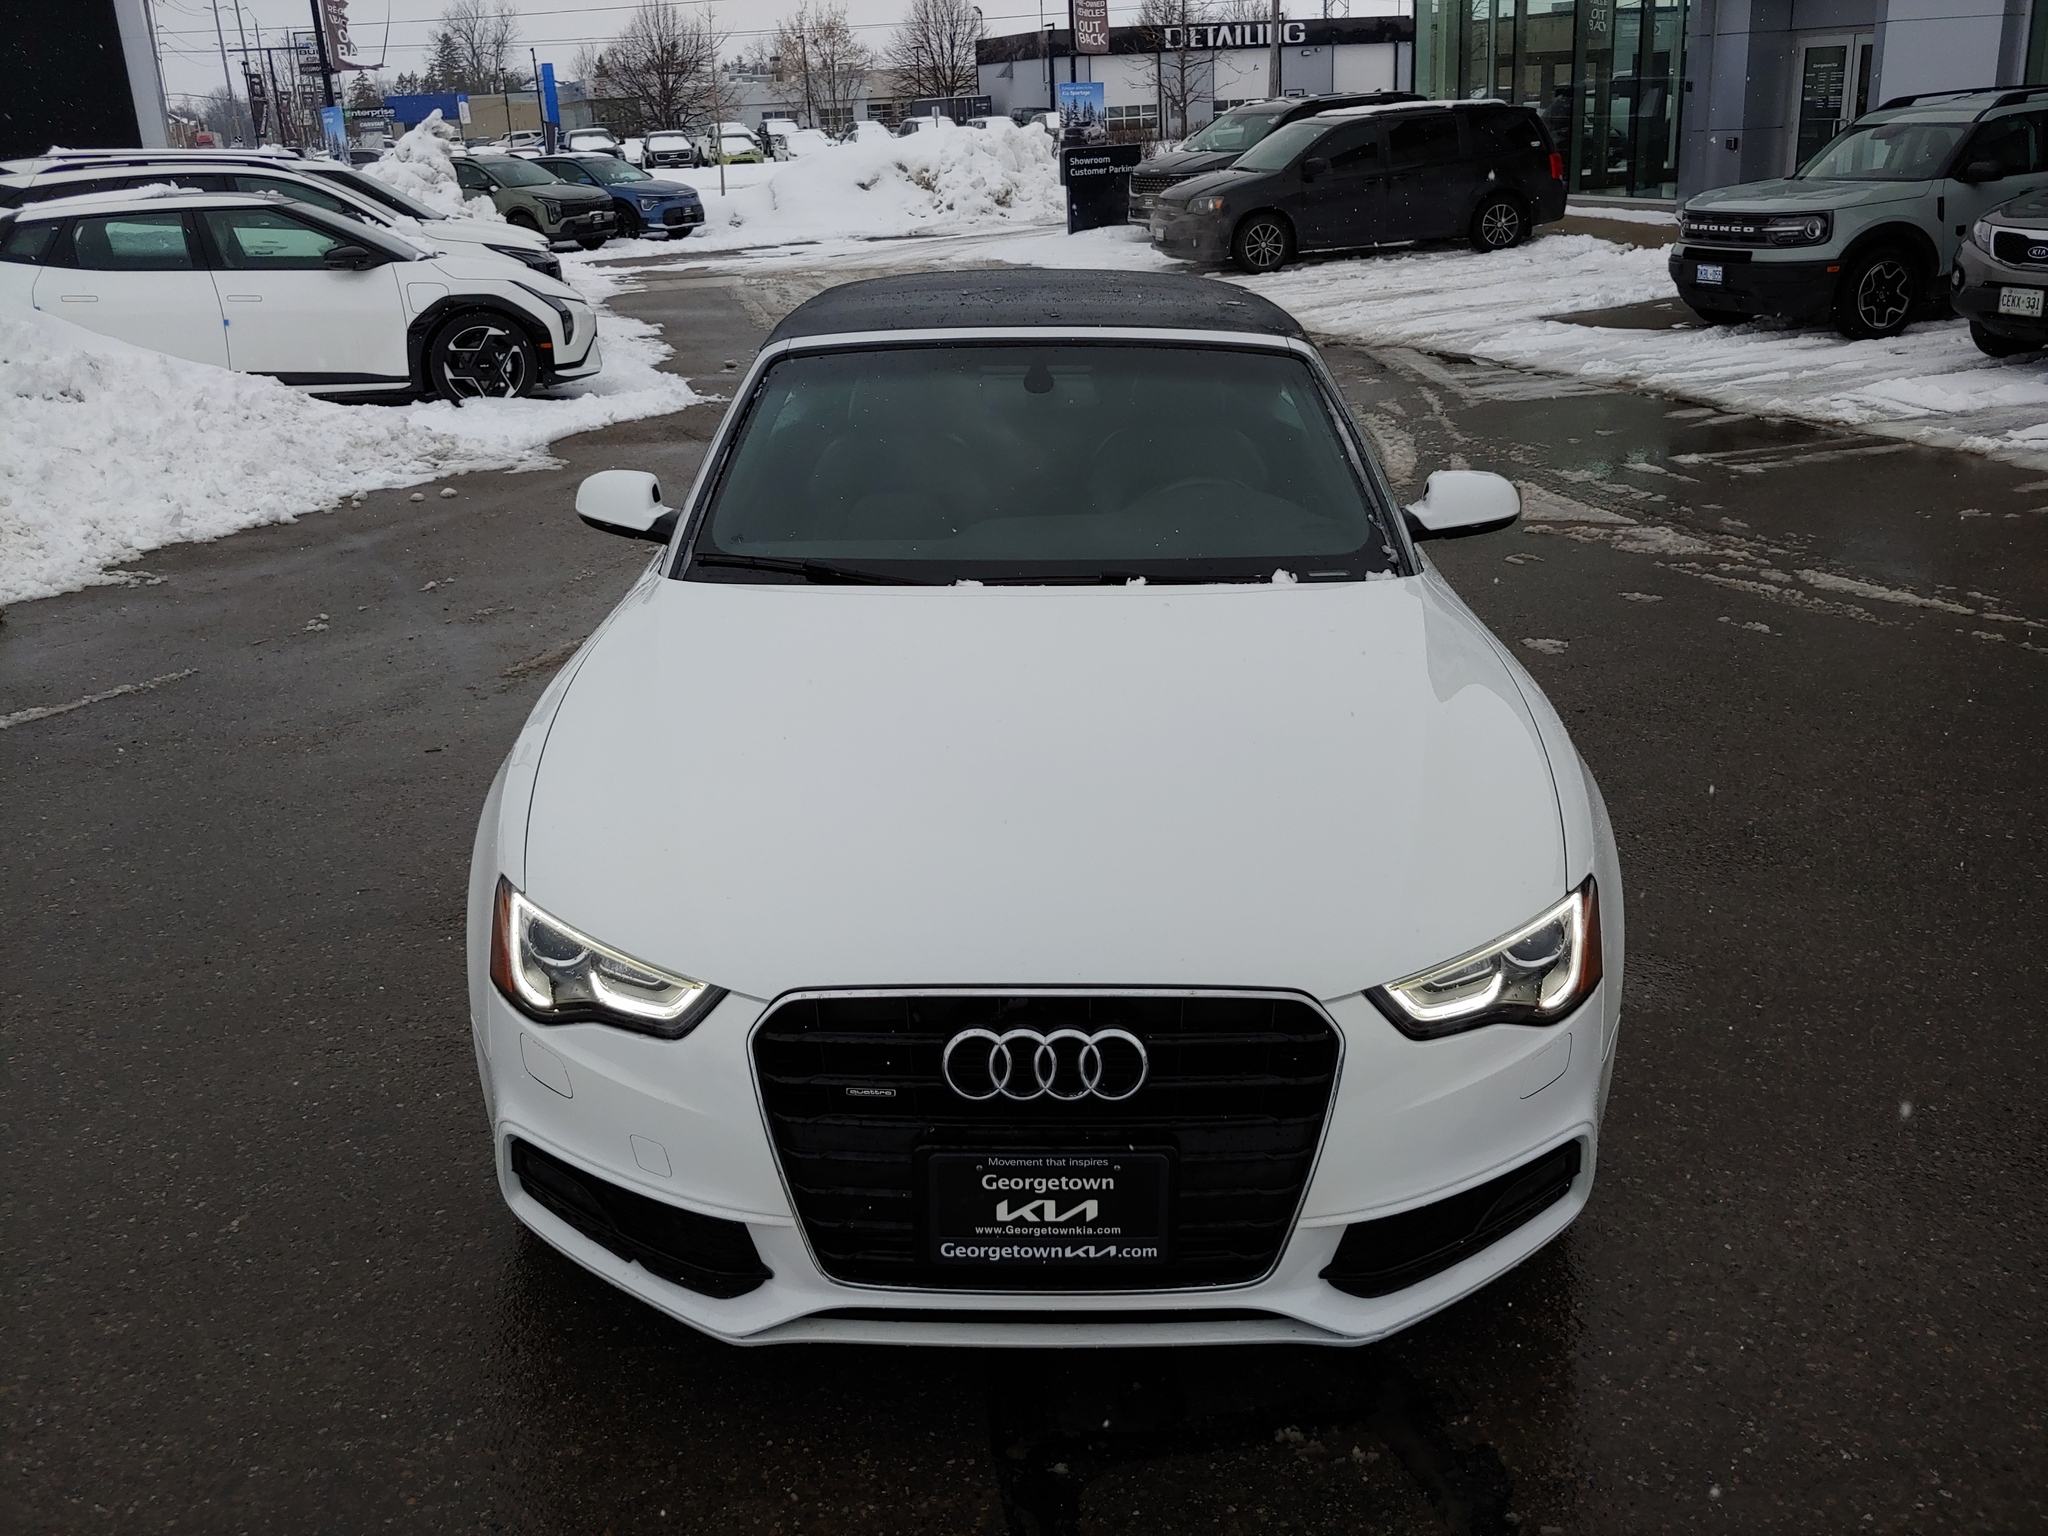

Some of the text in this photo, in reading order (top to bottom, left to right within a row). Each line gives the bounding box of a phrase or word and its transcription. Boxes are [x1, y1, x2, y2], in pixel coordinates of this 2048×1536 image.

[1079, 20, 1101, 33] OUT
[1078, 32, 1106, 46] BACK
[1164, 22, 1306, 49] DETAILING
[337, 44, 358, 58] BA
[344, 107, 395, 118] enterprise
[1069, 156, 1111, 166] Showroom
[1070, 167, 1107, 177] Customer
[1690, 223, 1755, 233] BRONCO
[2031, 248, 2046, 256] KIA
[988, 1157, 1109, 1168] Movement that inspires
[981, 1174, 1115, 1194] Georgetown
[996, 1199, 1098, 1222] KIA
[975, 1225, 1121, 1237] www.Georgetownkia.com
